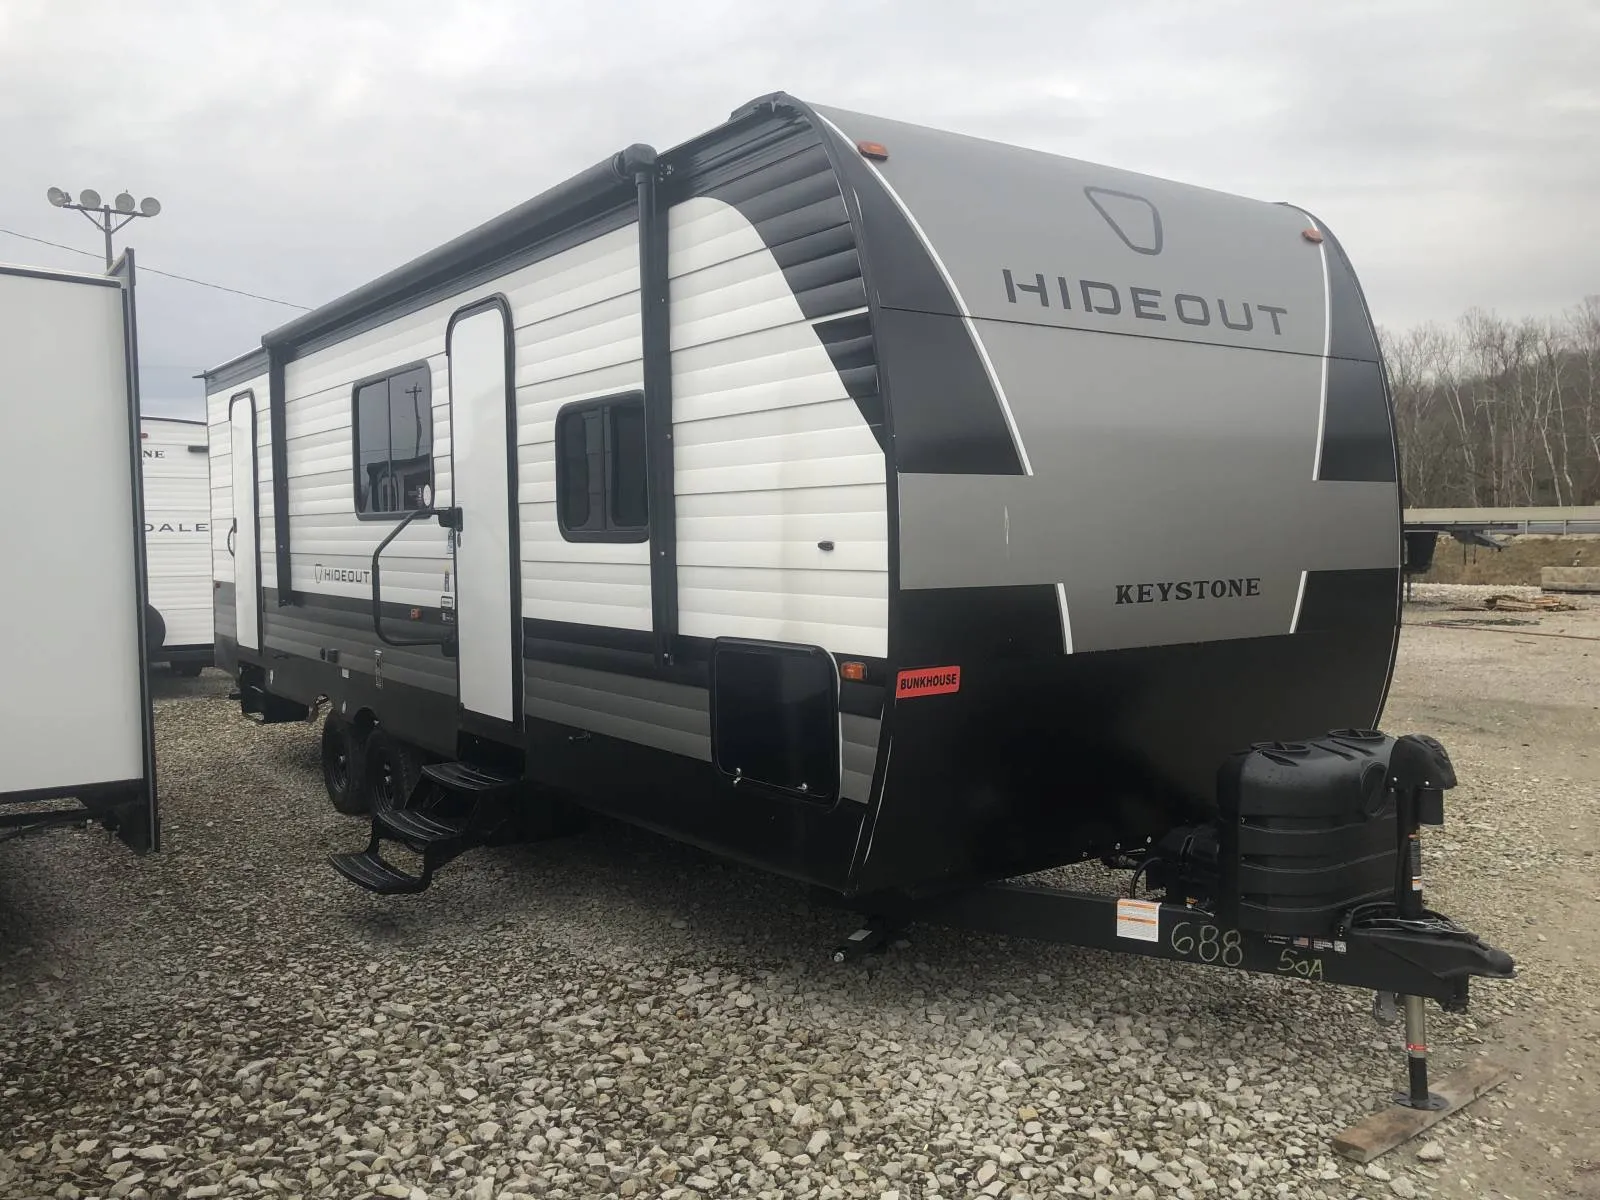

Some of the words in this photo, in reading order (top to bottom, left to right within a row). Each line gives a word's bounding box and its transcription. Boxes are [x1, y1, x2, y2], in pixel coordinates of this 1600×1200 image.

[1002, 269, 1287, 335] HIDEOUT
[145, 523, 209, 532] DALE
[324, 568, 370, 583] HIDEOUT
[1115, 577, 1261, 605] KEYSTONE
[900, 673, 957, 690] BUNKHOUSE
[1171, 921, 1243, 967] 688
